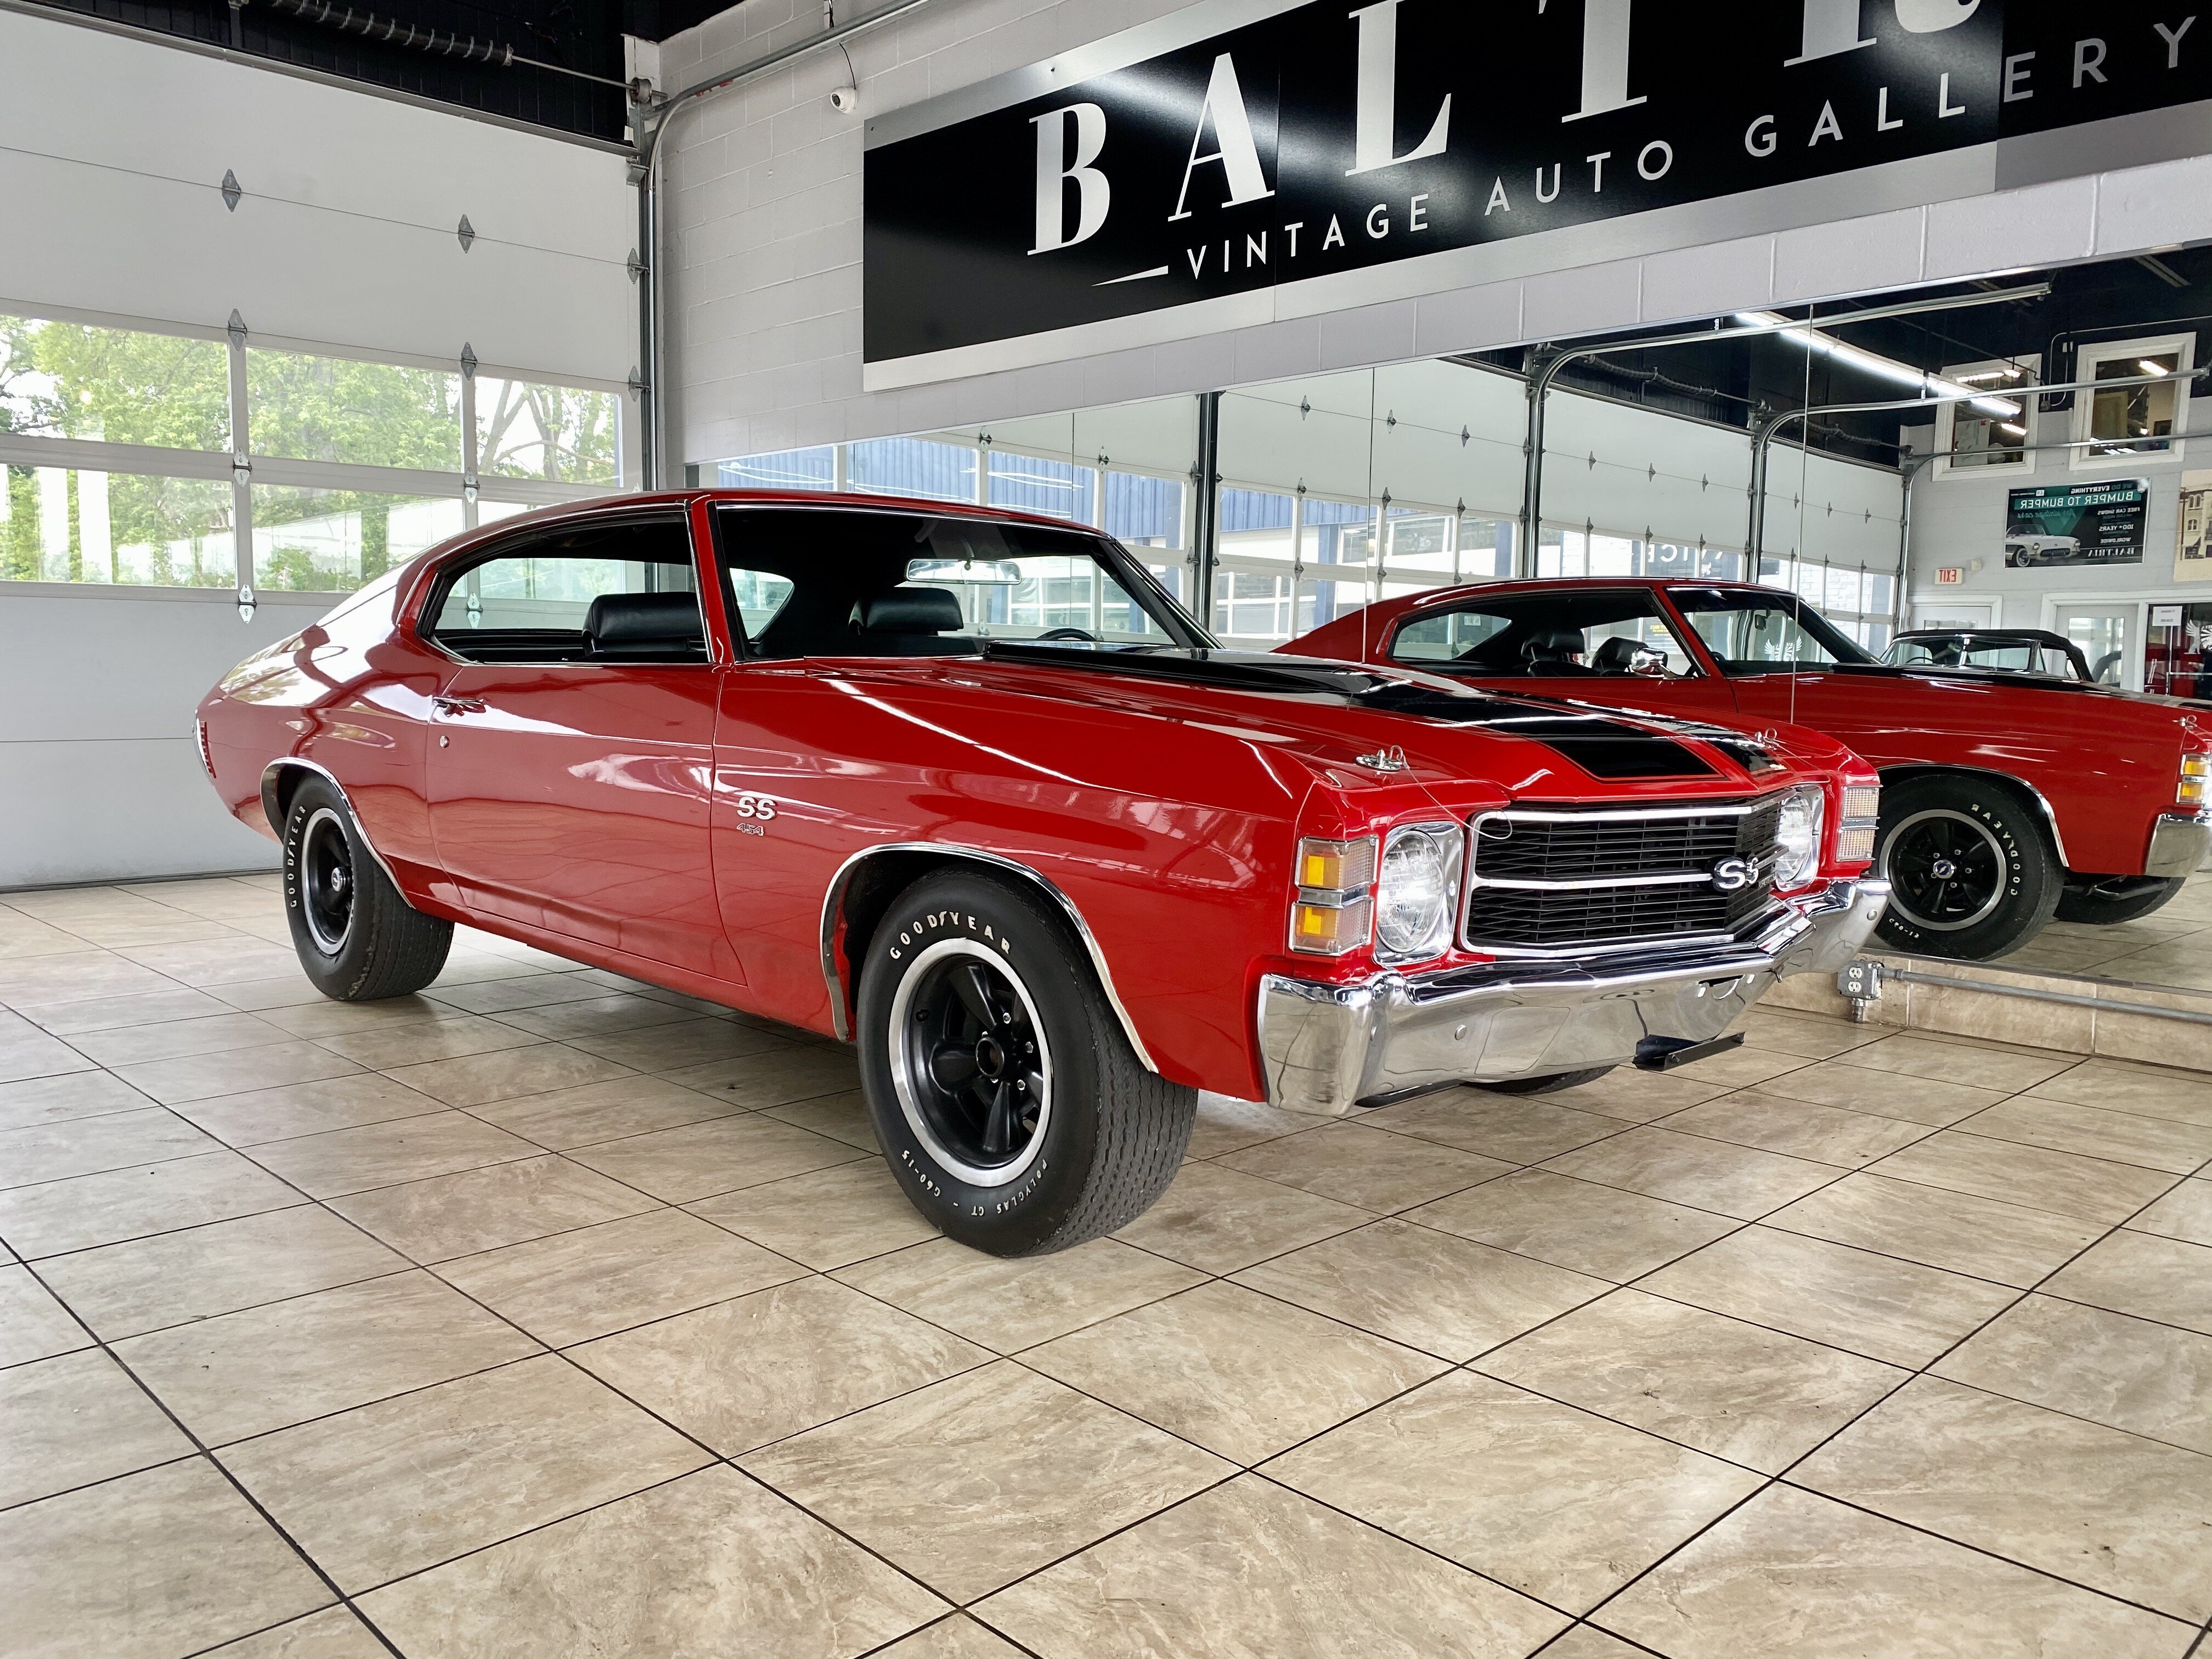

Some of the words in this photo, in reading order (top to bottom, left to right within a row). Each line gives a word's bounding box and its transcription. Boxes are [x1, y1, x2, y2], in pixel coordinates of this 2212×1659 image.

[1027, 0, 1980, 256] BALT
[1187, 192, 1429, 280] VINTAGE
[1484, 139, 1674, 216] AUTO
[1745, 15, 2197, 157] GALLERY
[736, 822, 765, 836] 454
[737, 796, 777, 820] SS
[287, 805, 306, 907] GOODYEAR
[889, 911, 1012, 960] GOODYEAR
[901, 1149, 942, 1198] G60-15
[996, 1158, 1048, 1215] POLYGLAS
[970, 1205, 985, 1217] GT
